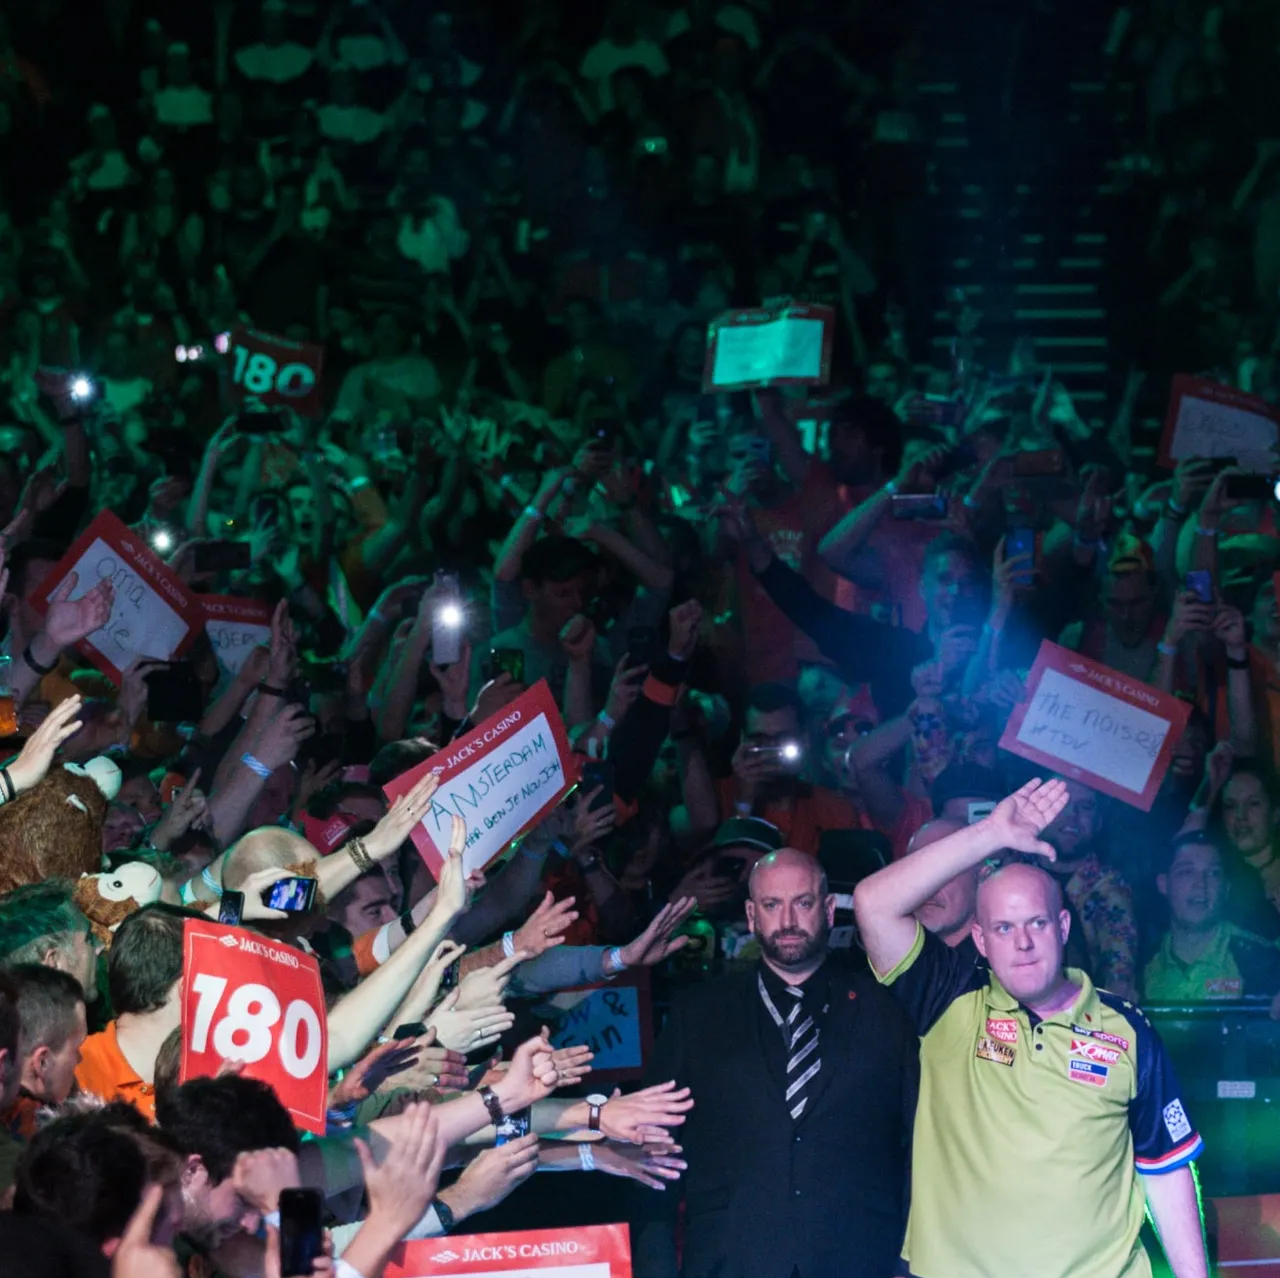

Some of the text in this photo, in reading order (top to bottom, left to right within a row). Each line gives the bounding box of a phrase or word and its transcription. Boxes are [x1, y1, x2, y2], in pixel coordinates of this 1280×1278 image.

[232, 344, 316, 397] 180
[160, 578, 188, 608] CASINO
[446, 710, 522, 769] JACK'S CASINO
[430, 732, 547, 832] AMSTERDAM
[240, 937, 299, 969] JACK'S CASINO
[191, 973, 322, 1079] 180
[990, 1030, 1017, 1041] ASINO
[462, 1241, 578, 1262] JACK'S CASINO
